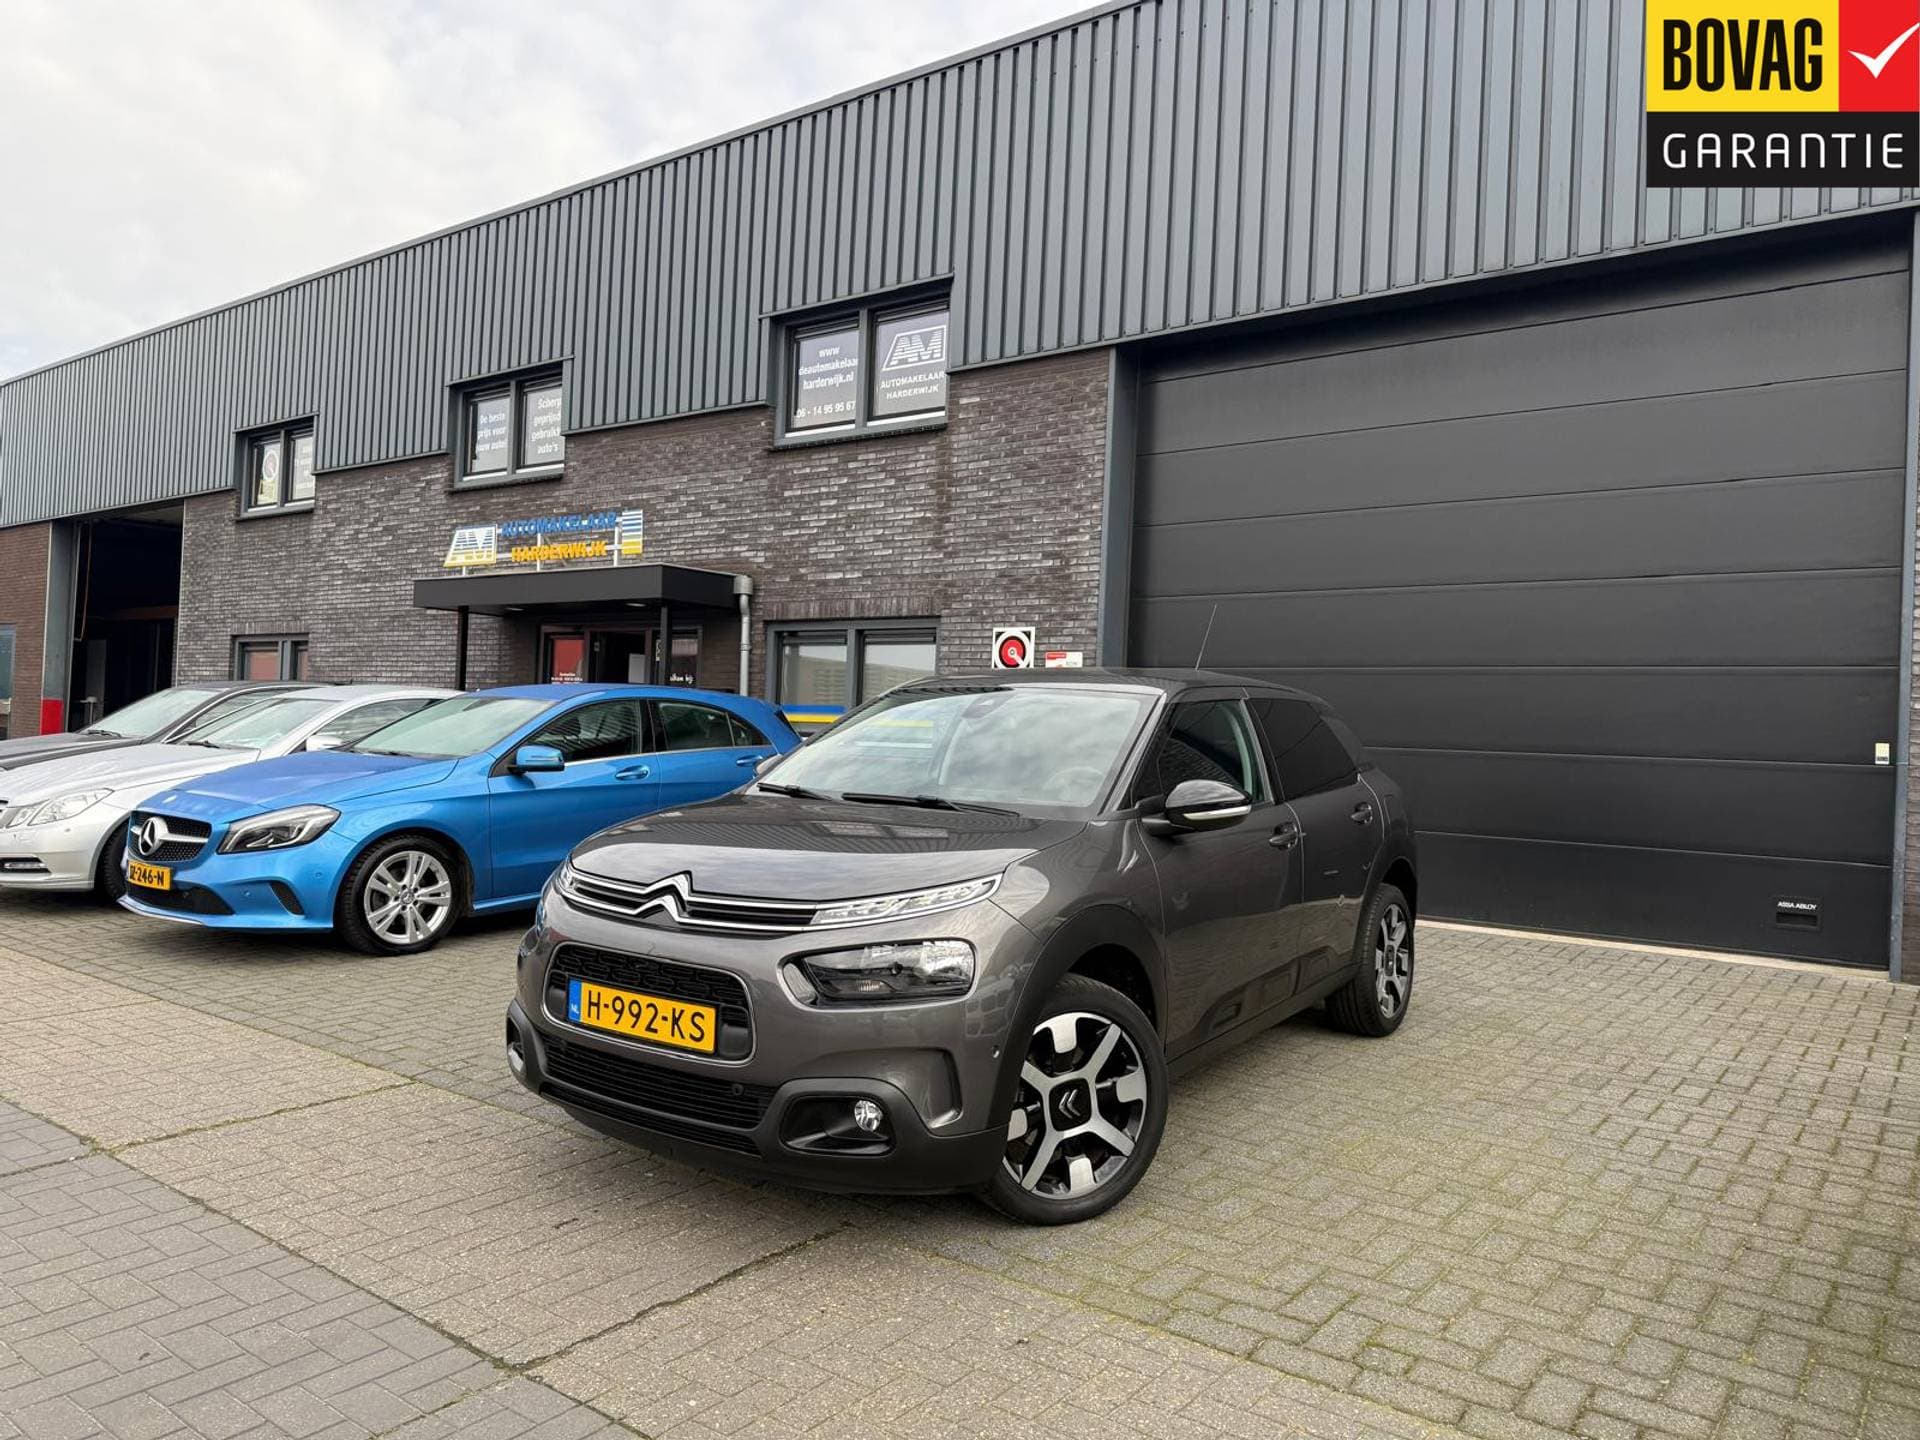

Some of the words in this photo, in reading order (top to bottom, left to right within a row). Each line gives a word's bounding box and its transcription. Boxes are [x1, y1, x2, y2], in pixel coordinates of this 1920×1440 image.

[818, 346, 841, 358] www
[802, 371, 855, 391] harderwijk.nl
[879, 371, 946, 389] AUTOMAKELAAR
[886, 384, 940, 400] HARDERWIJK
[813, 405, 822, 416] 14
[846, 400, 857, 411] 67
[500, 512, 617, 537] AUTOMAKELAAR
[511, 540, 608, 562] HARDERWIJK
[587, 989, 705, 1042] H-992-KS
